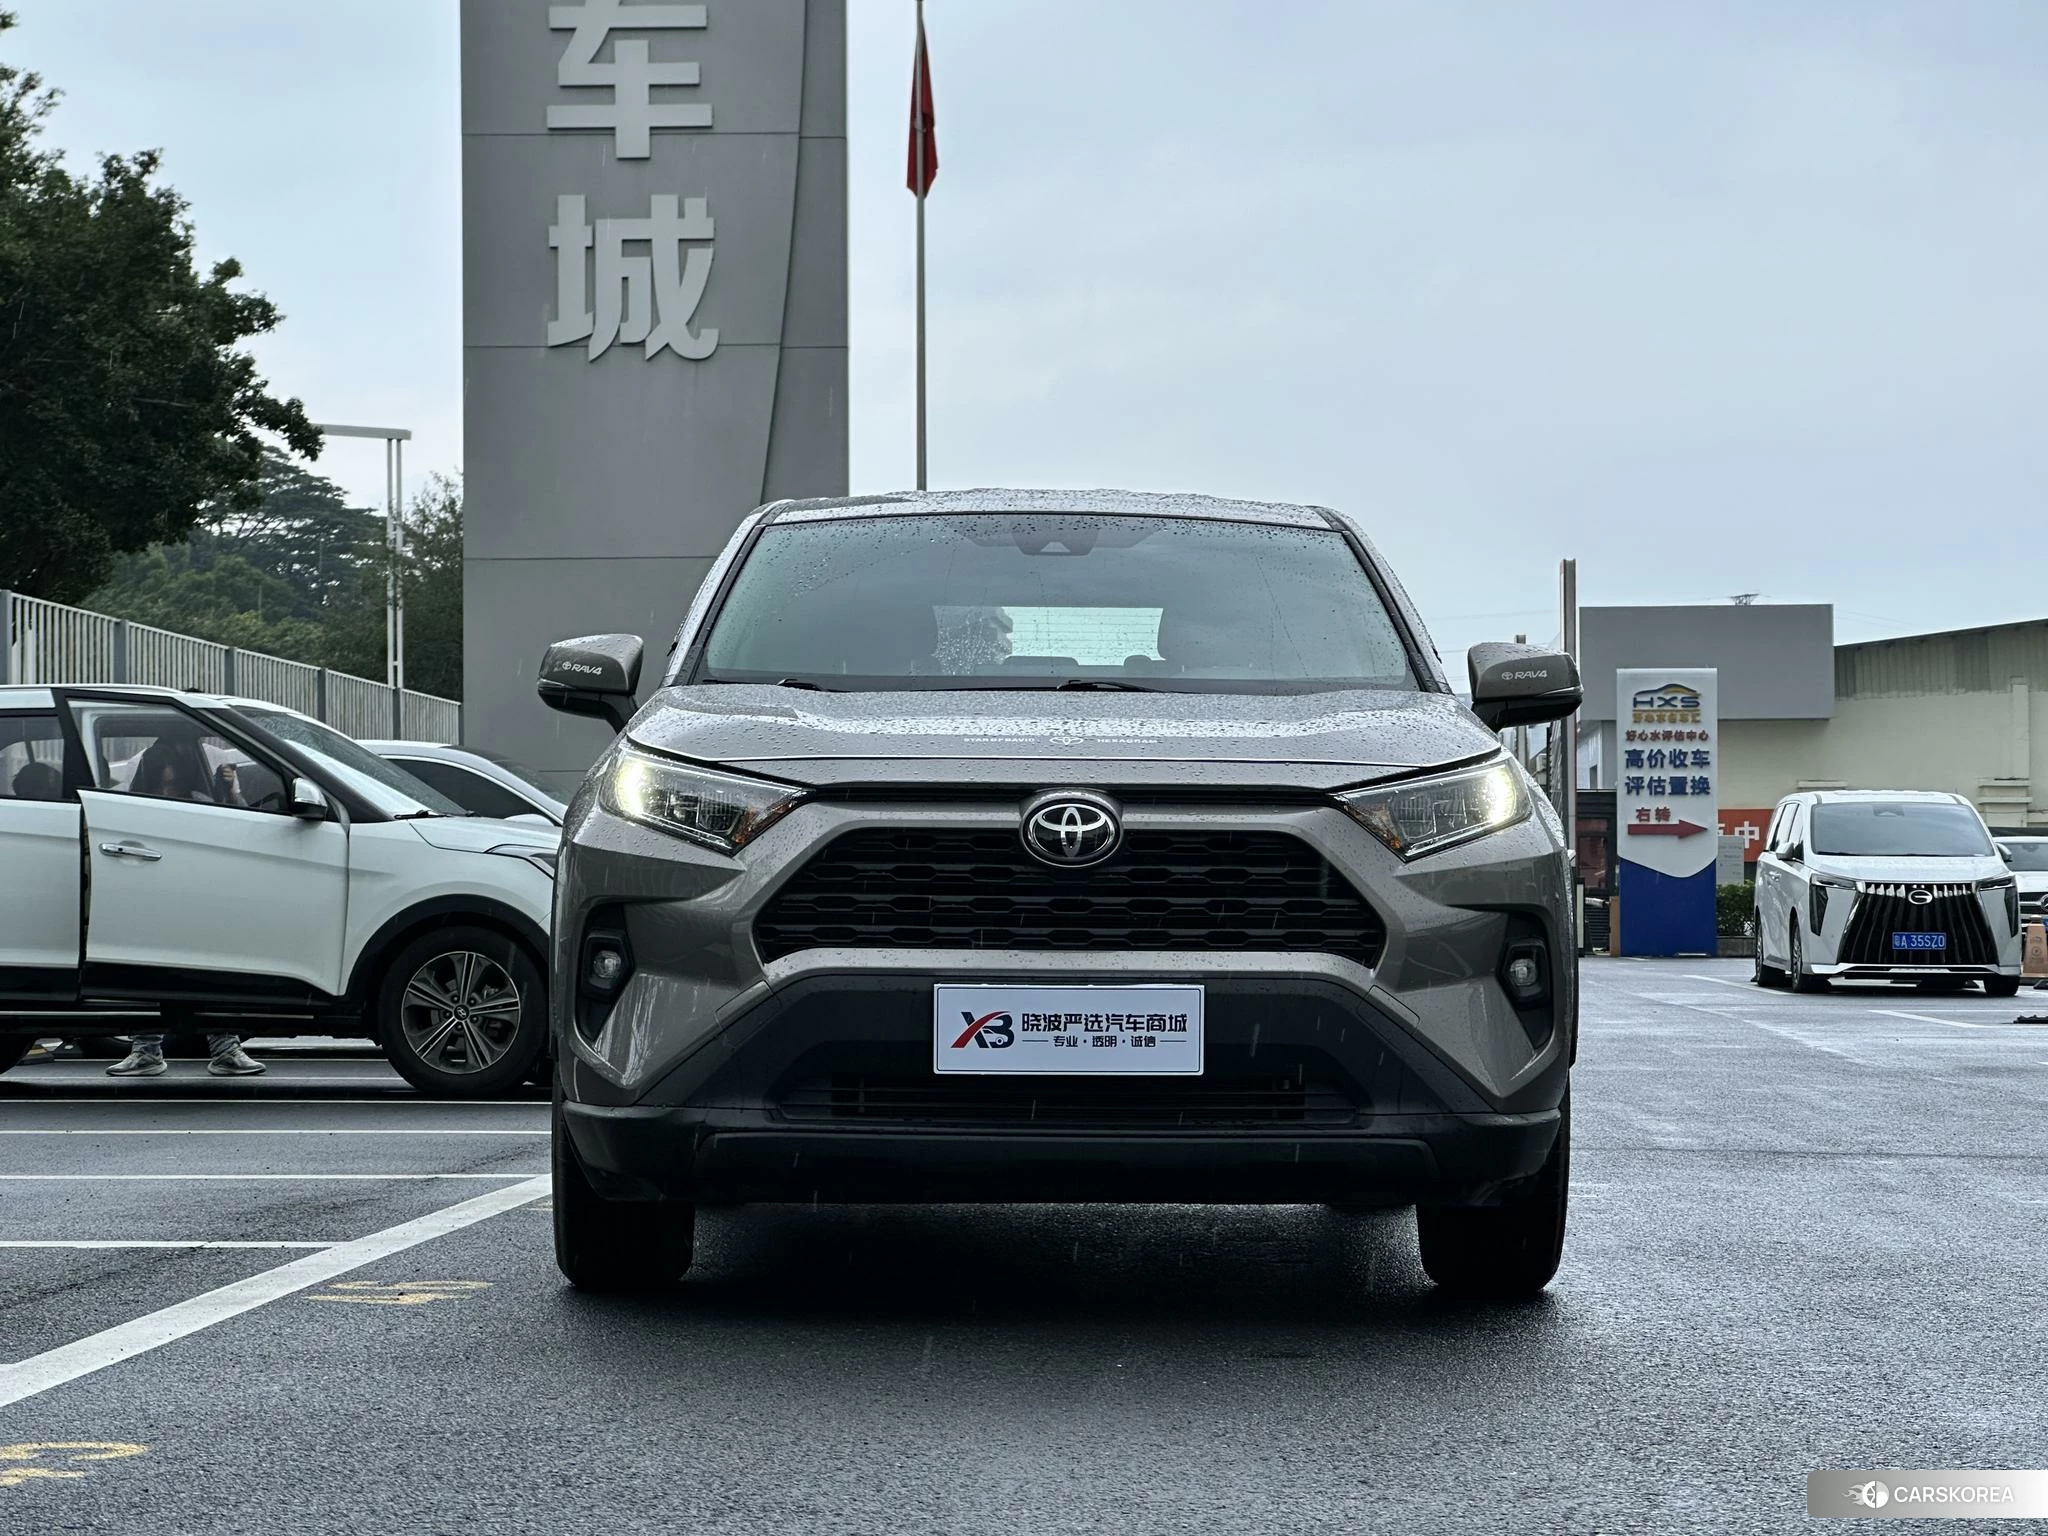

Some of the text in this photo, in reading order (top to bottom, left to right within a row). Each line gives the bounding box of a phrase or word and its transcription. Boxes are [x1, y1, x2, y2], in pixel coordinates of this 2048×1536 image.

[547, 0, 720, 362] 车城
[571, 664, 602, 675] RAV4
[1514, 670, 1547, 679] RAV4
[1632, 696, 1701, 708] HXS
[1625, 749, 1711, 768] 高价收车
[1625, 775, 1711, 796] 评估置换
[1635, 806, 1671, 822] 右转
[1021, 1013, 1188, 1033] 晓波严选汽车商城
